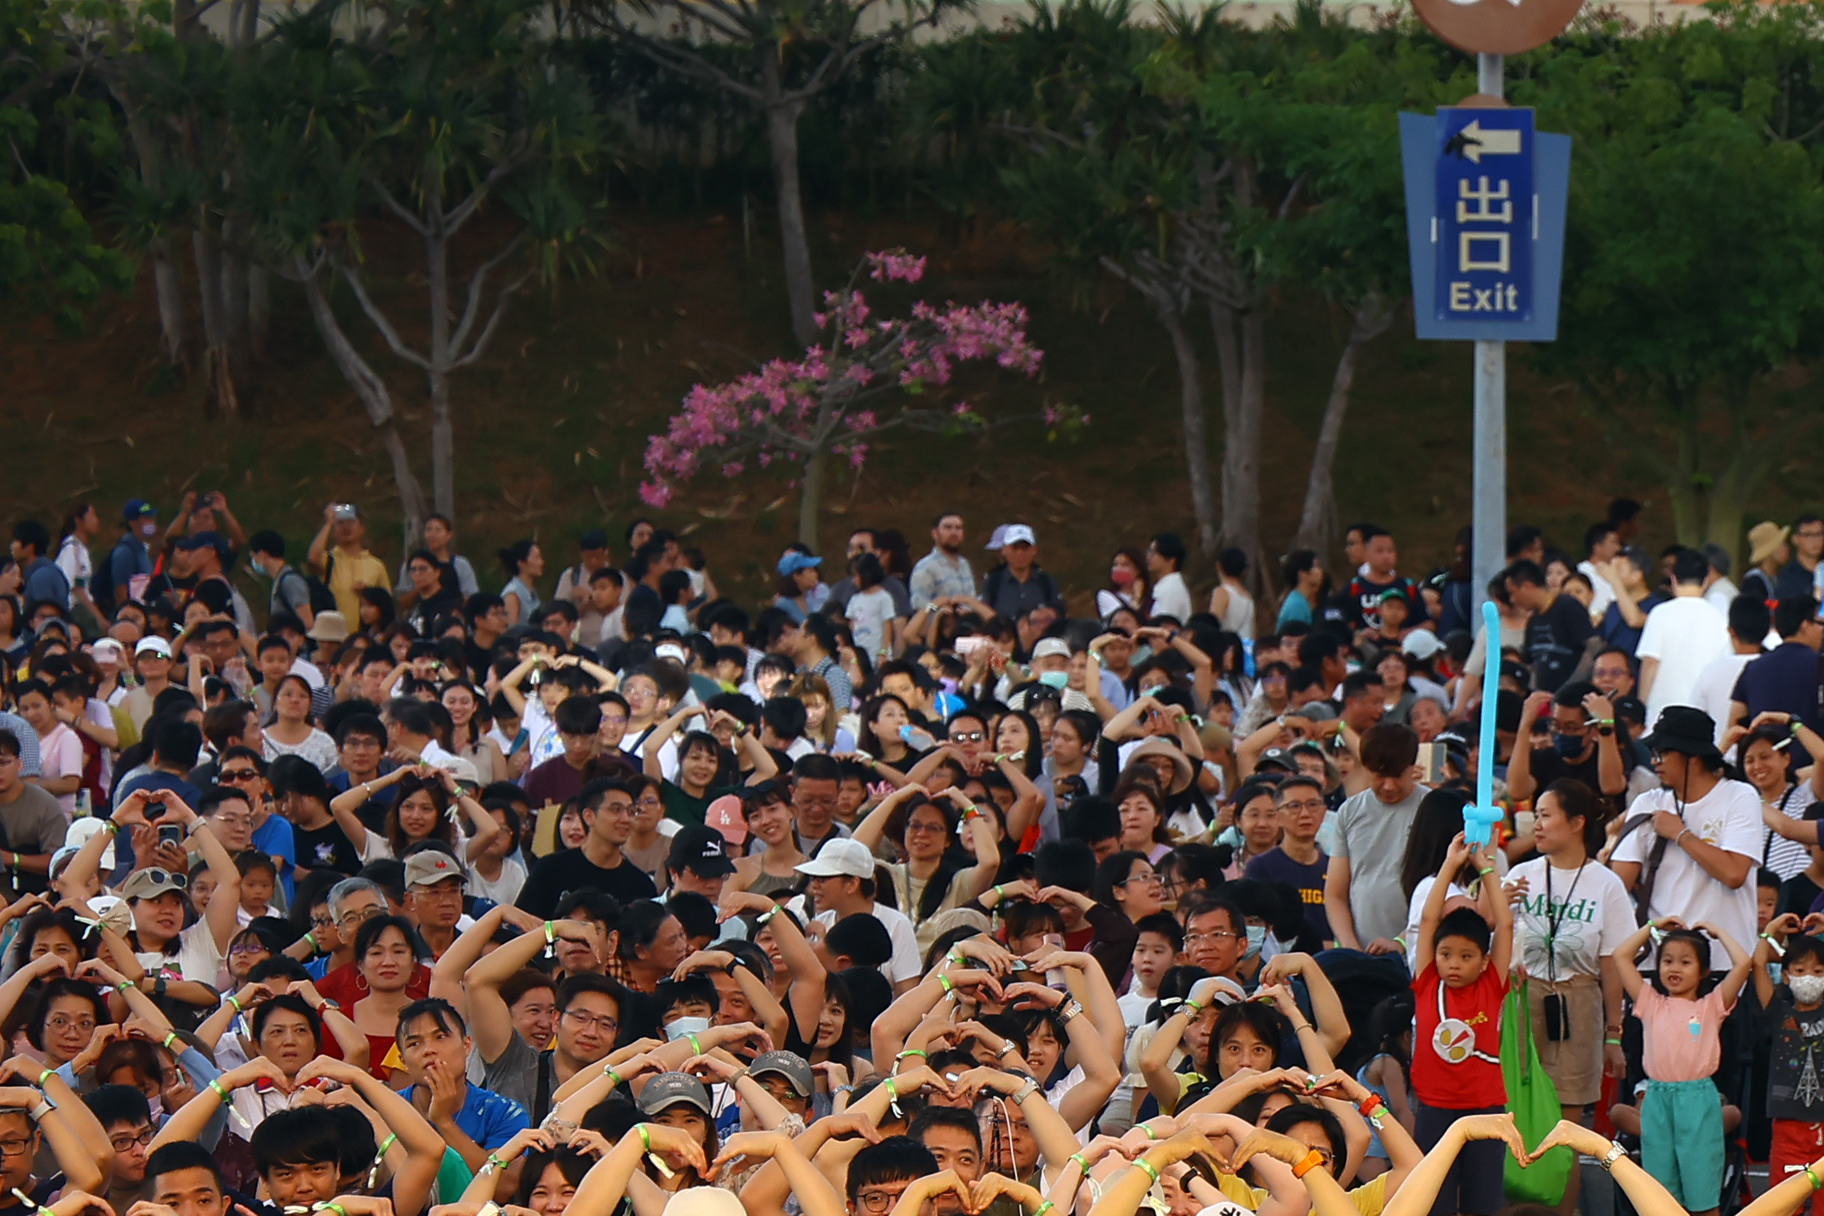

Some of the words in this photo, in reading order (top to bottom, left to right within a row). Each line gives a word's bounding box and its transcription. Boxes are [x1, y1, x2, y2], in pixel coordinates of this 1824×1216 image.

[1456, 176, 1512, 273] 出口
[1449, 281, 1519, 312] Exit
[1519, 893, 1596, 923] Mardi
